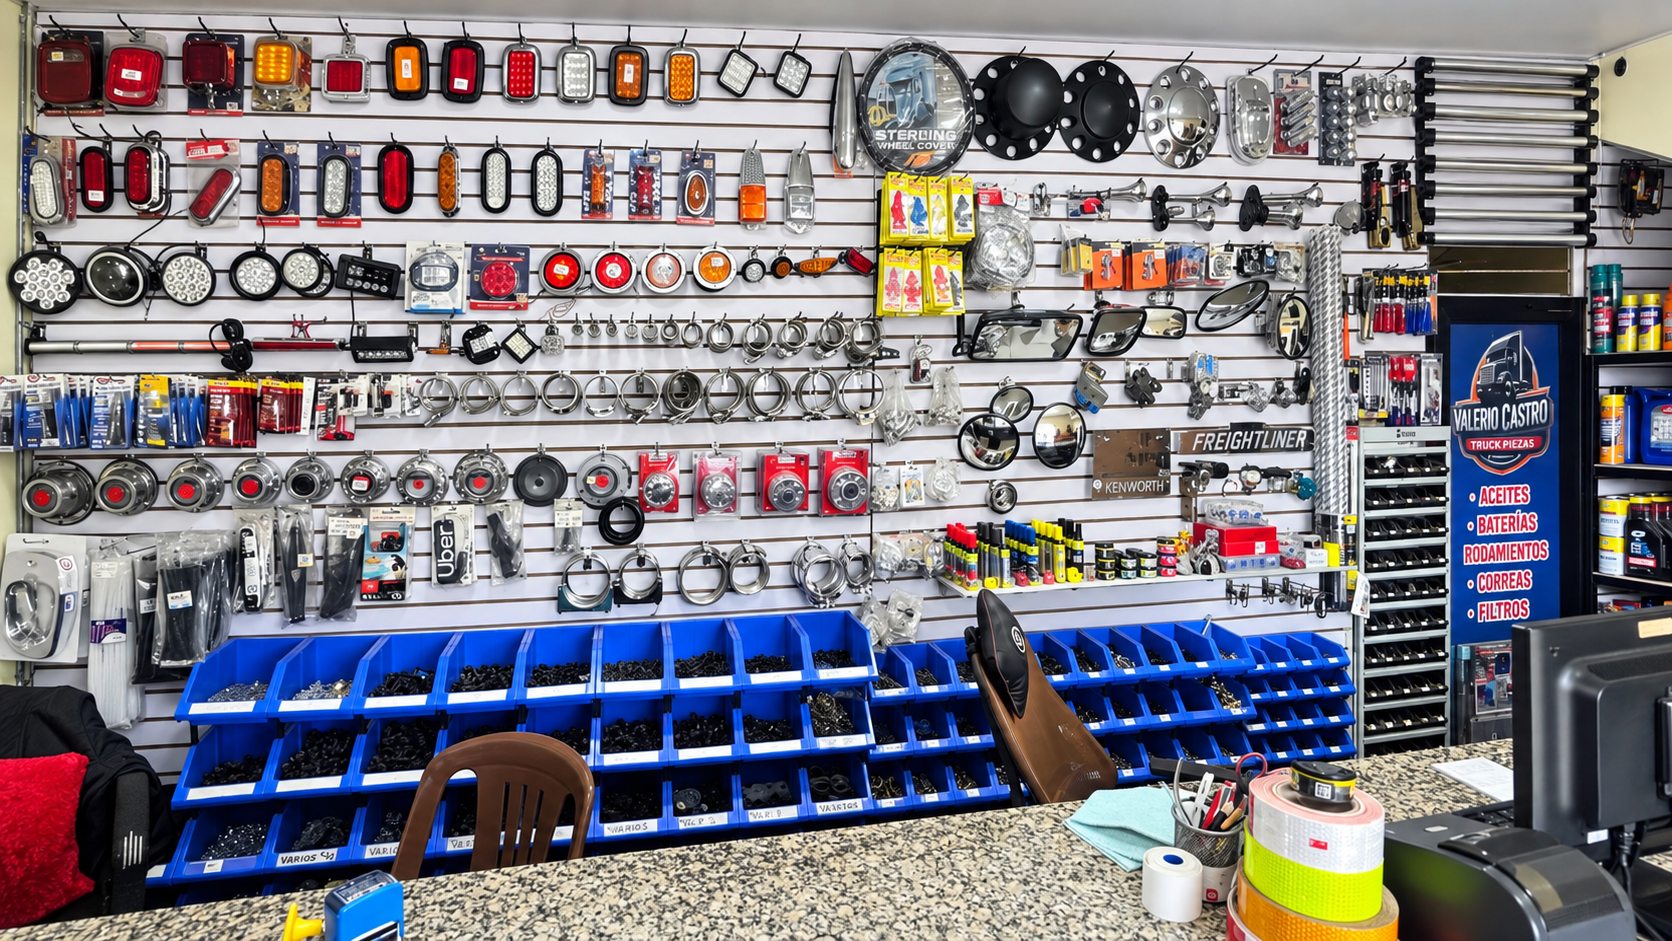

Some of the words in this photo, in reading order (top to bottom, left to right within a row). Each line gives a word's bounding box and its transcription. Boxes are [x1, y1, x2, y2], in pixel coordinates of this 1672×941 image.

[875, 129, 957, 141] STERLING
[877, 141, 915, 150] WHEEL
[917, 141, 956, 150] COVER
[1453, 406, 1499, 432] VALERIO
[1501, 398, 1549, 431] CASTRO
[1192, 429, 1308, 451] FREIGHTLINER
[1470, 440, 1502, 450] TRUCK
[1502, 438, 1535, 449] PIEZAS
[1105, 480, 1164, 494] KENWORTH
[1479, 485, 1530, 506] ACEITES
[1477, 510, 1537, 535] BATERÍAS
[437, 525, 455, 577] Uber
[1464, 541, 1549, 565] RODAMIENTOS
[1477, 570, 1532, 593] CORREAS
[1478, 599, 1529, 622] FILTROS
[280, 853, 317, 865] VARIOS
